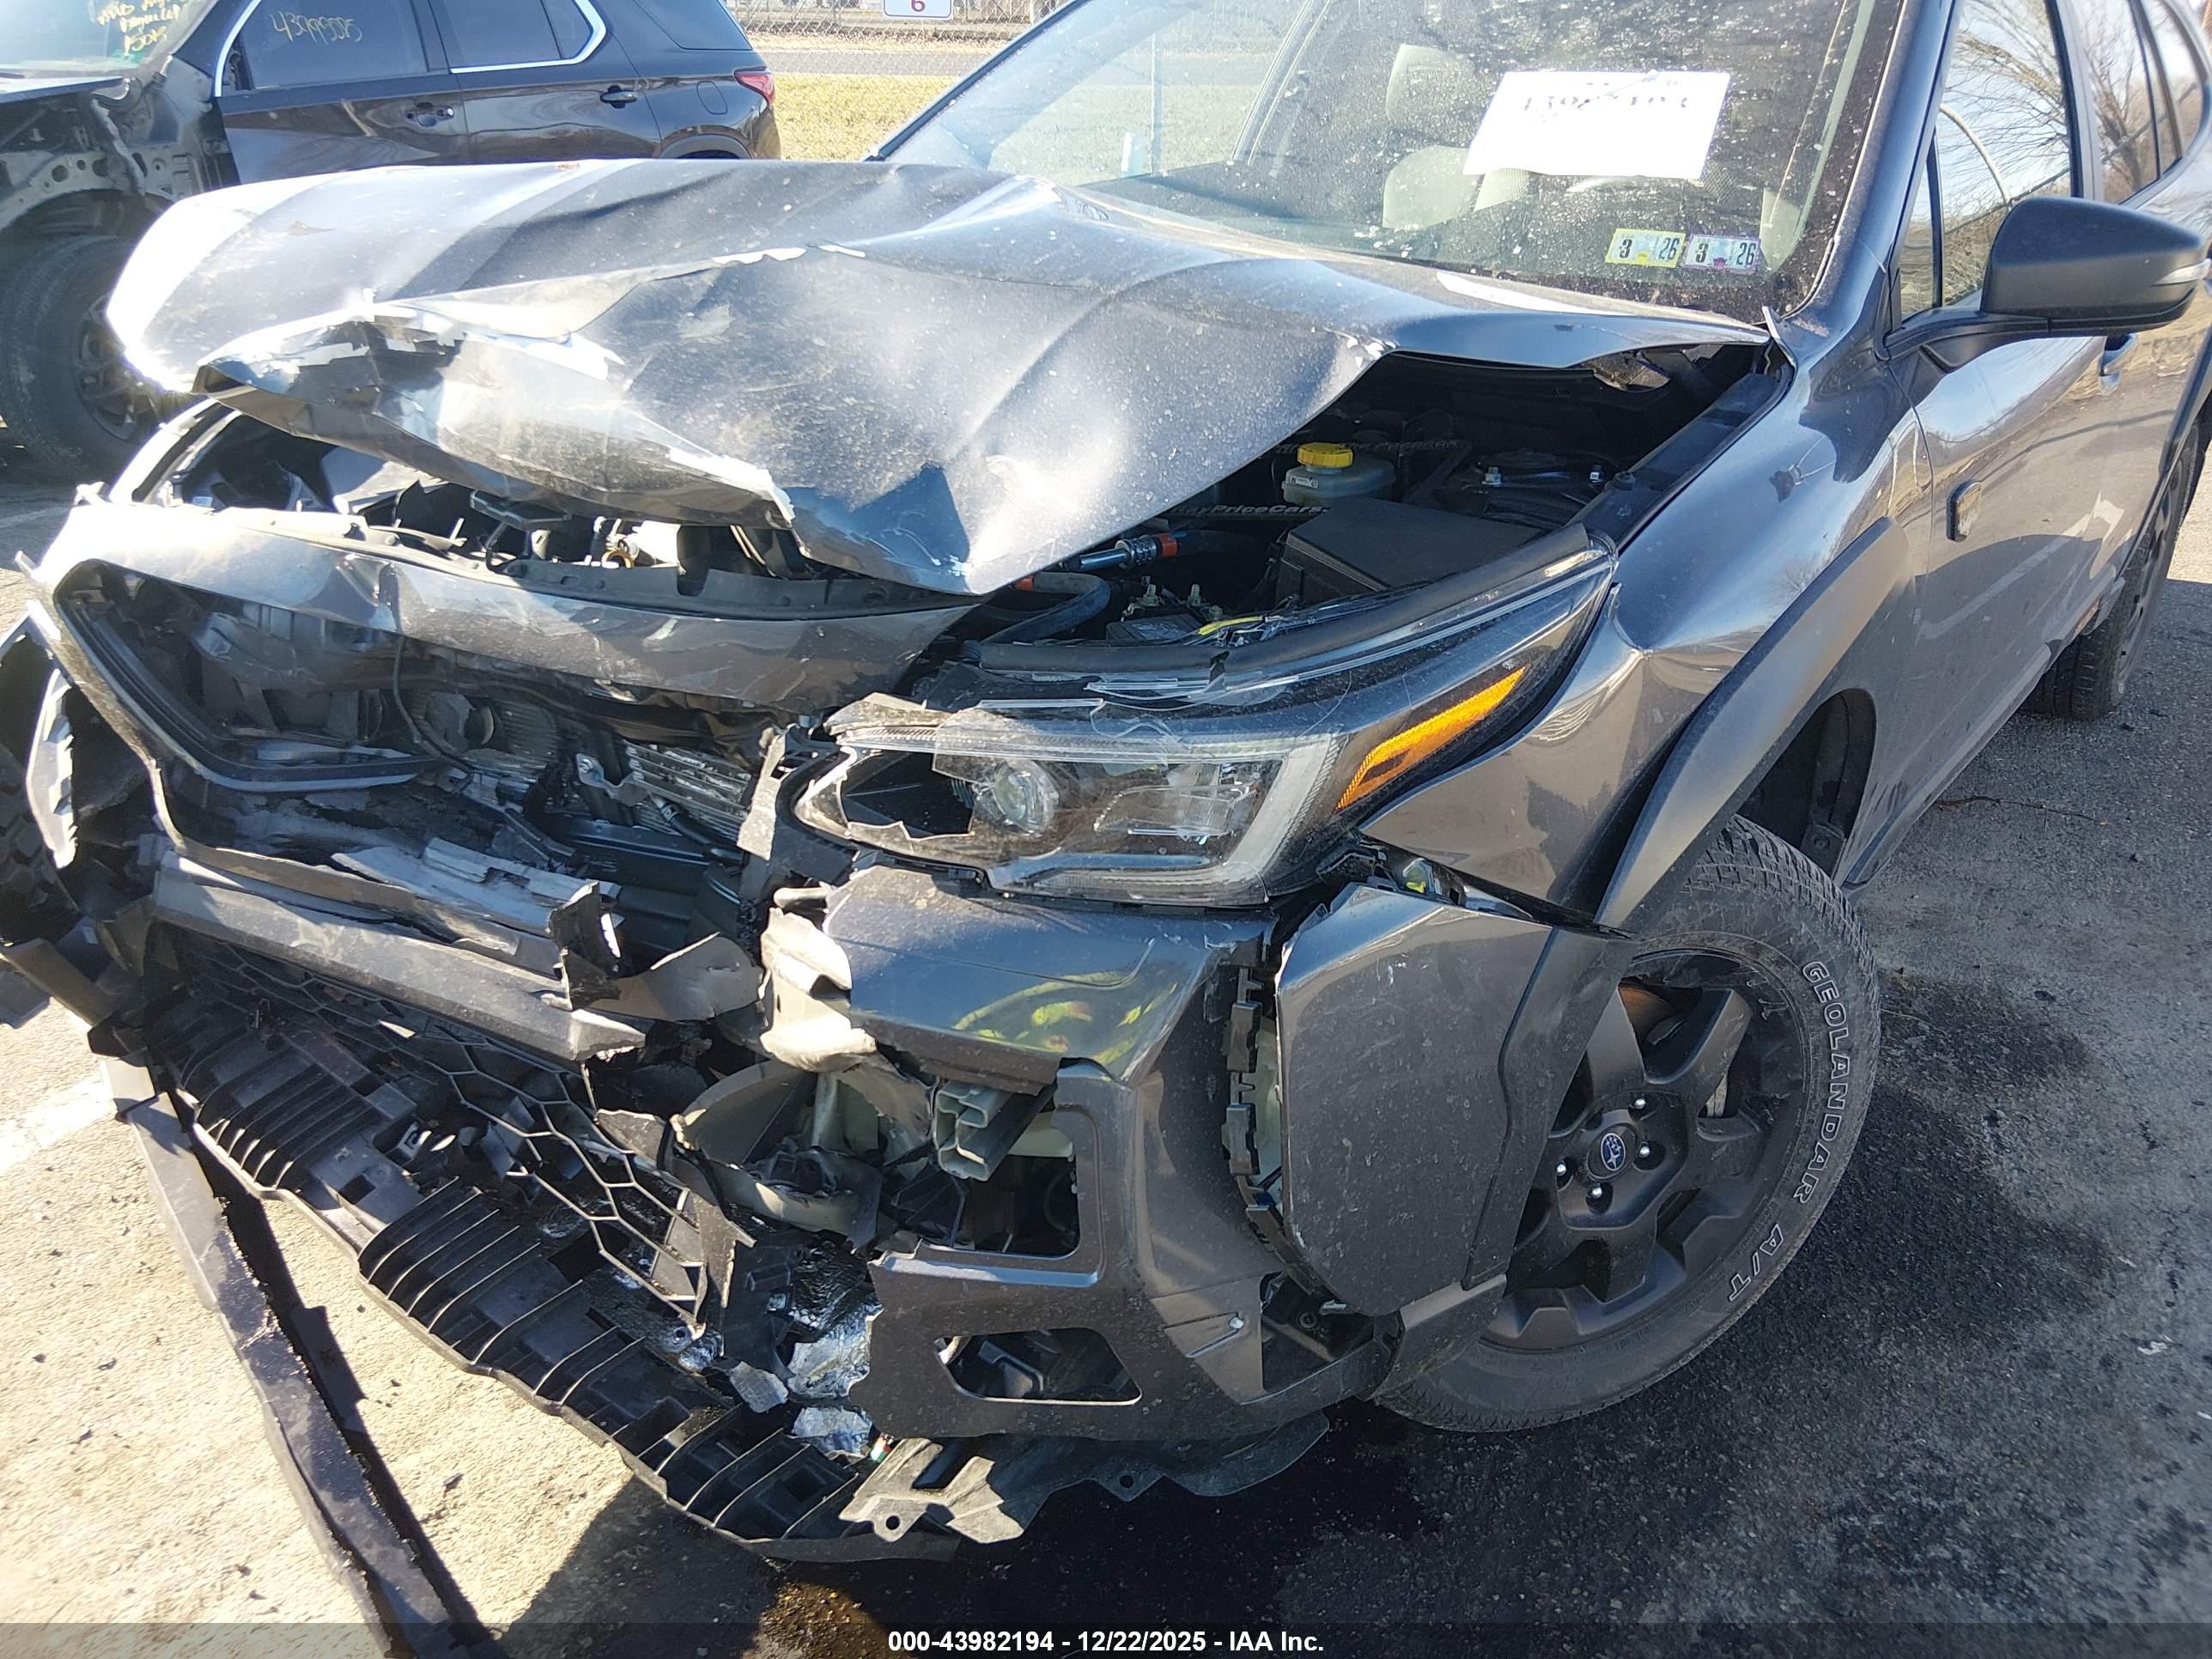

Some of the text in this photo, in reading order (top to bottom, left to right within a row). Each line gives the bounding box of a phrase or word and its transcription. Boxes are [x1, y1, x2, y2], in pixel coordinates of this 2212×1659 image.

[1619, 237, 1680, 261] 3 26
[1695, 242, 1757, 265] 3 26
[1727, 960, 1851, 1304] GEOLANDAR A/T
